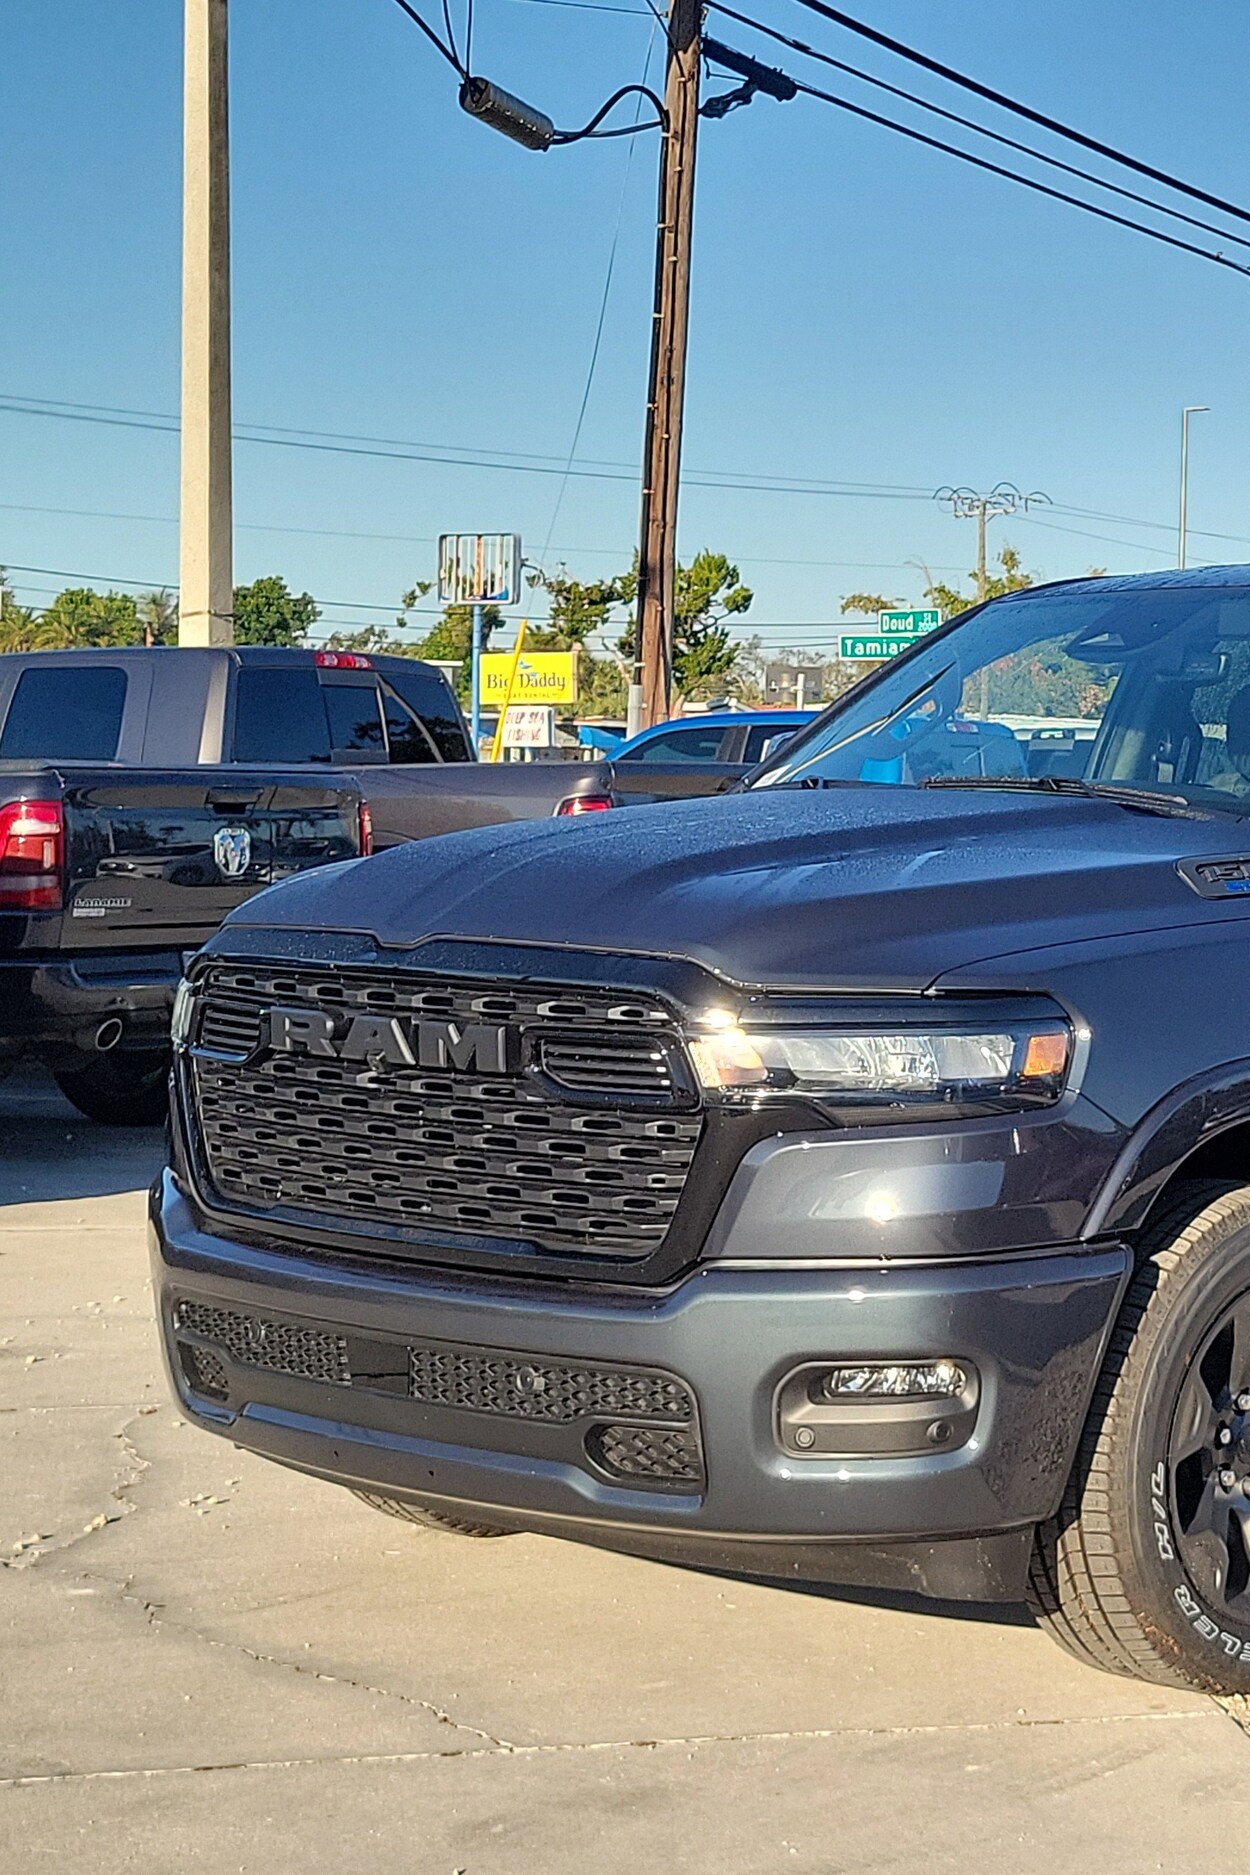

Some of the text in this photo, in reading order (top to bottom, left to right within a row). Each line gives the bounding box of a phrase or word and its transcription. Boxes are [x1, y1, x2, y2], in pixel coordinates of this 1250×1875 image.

[882, 614, 914, 631] Doud
[519, 672, 566, 691] Daddy
[269, 1005, 508, 1074] RAM
[1150, 1461, 1174, 1560] H/L
